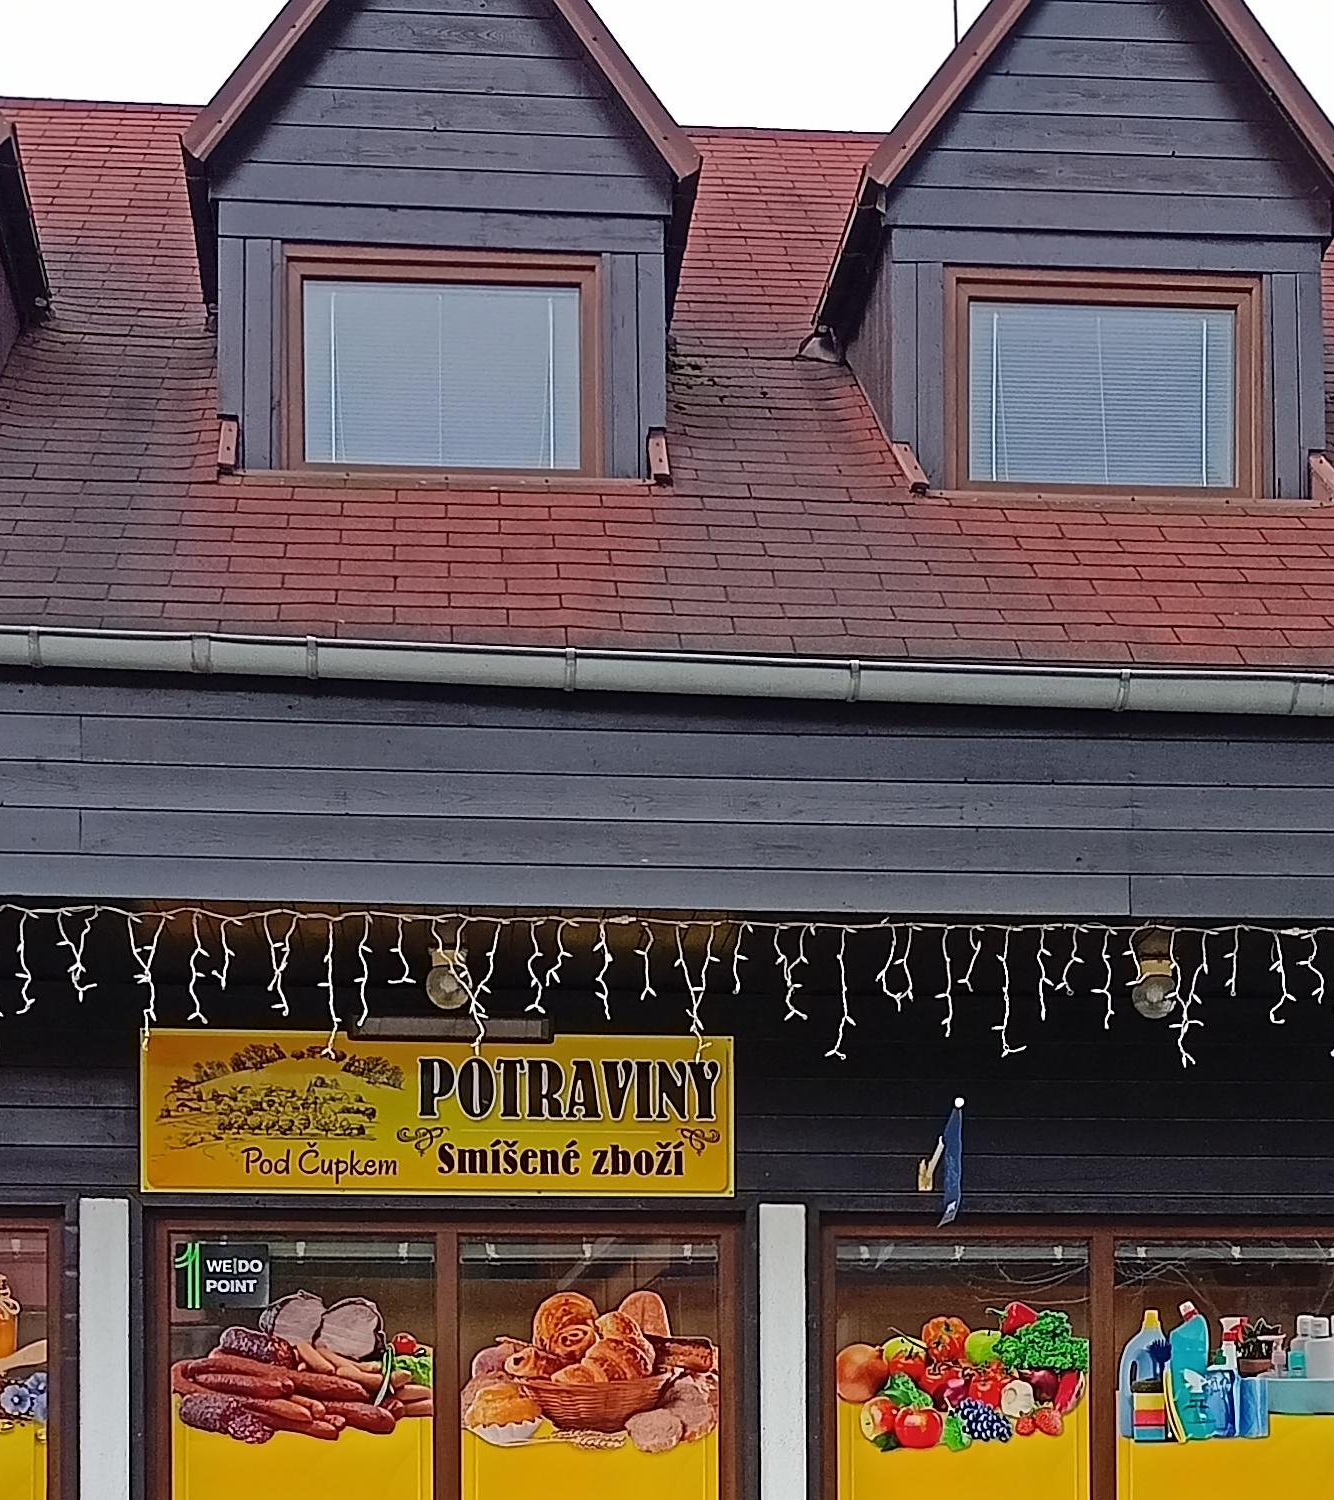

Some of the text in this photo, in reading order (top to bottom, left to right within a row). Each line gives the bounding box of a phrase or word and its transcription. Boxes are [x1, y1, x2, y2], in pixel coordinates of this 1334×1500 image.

[418, 1057, 721, 1122] POTRAVINY
[241, 1141, 399, 1184] Pod Čupkem
[437, 1140, 685, 1176] Smíšené zboží
[206, 1280, 257, 1292] POINT
